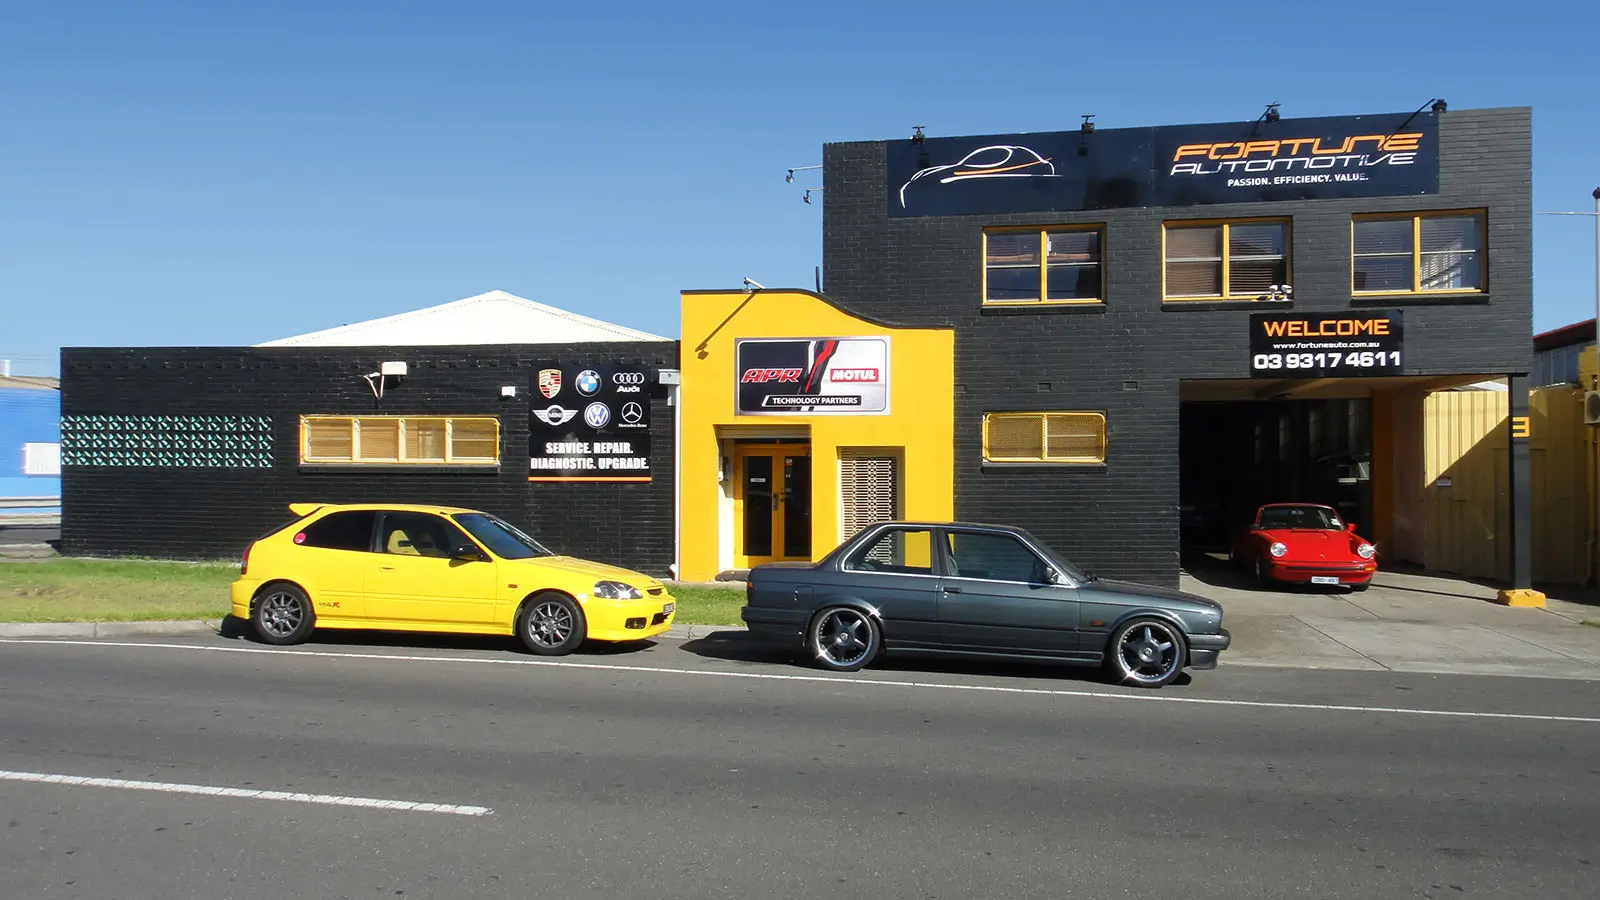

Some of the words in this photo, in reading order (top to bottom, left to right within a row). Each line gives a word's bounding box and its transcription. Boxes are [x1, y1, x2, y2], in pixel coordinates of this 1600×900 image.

[1173, 133, 1423, 161] FORTUNE
[1170, 152, 1417, 175] AUTOMOTIVE
[1227, 178, 1271, 187] PASSION.
[1274, 175, 1333, 185] EFFICIENCY.
[1263, 319, 1390, 337] WELCOME
[1253, 354, 1282, 369] 03
[1286, 352, 1342, 369] 9317
[1345, 351, 1400, 367] 4611
[741, 368, 803, 383] APR
[831, 369, 877, 381] MOTUL
[772, 396, 821, 405] TECHNOLOGY
[821, 396, 858, 404] PARTNERS
[545, 442, 592, 454] SERVICE.
[593, 442, 634, 454] REPAIR.
[530, 457, 597, 469] DIAGNOSTIC.
[598, 457, 650, 470] UPGRADE.
